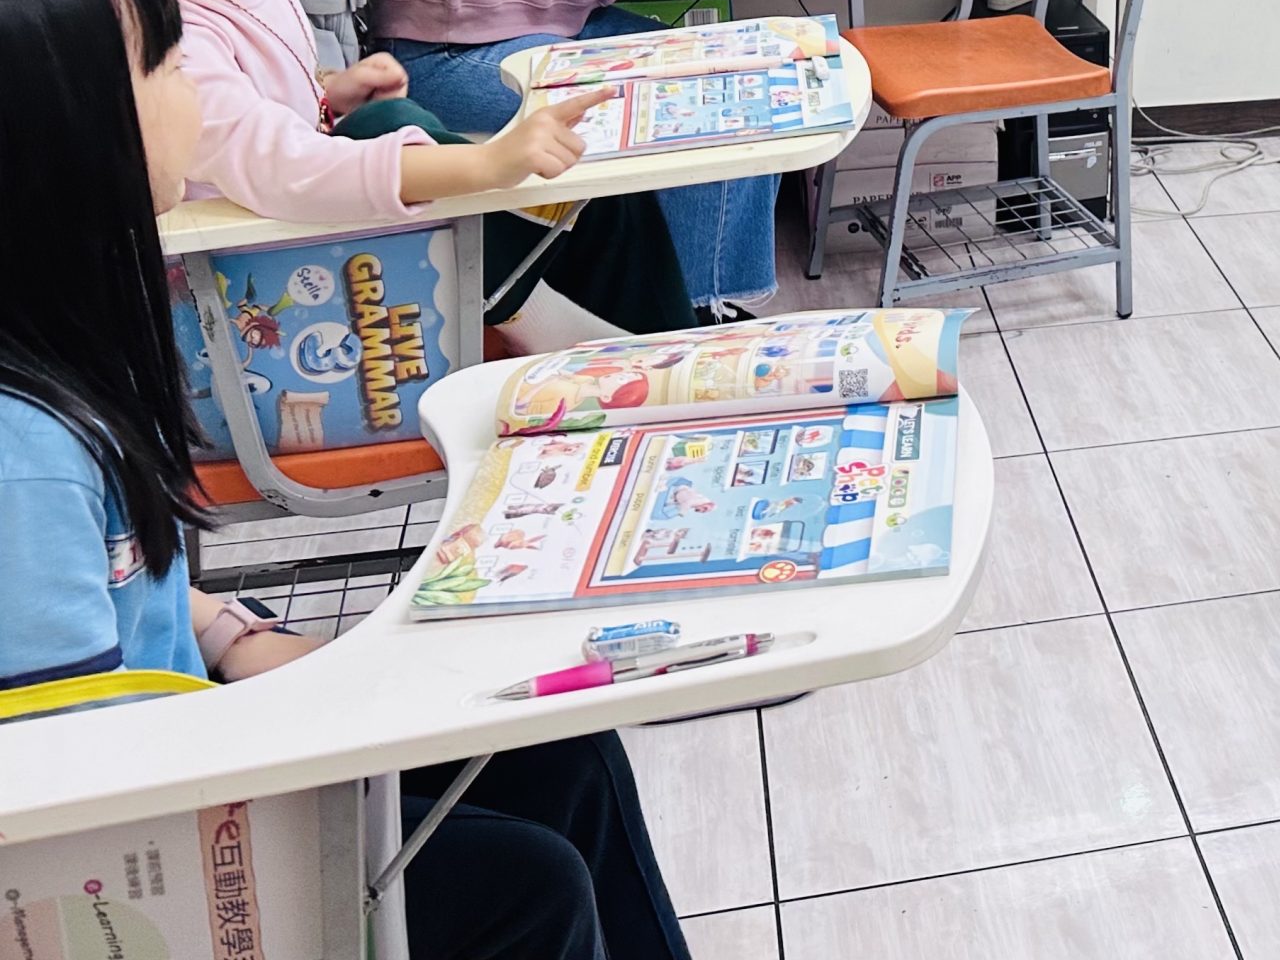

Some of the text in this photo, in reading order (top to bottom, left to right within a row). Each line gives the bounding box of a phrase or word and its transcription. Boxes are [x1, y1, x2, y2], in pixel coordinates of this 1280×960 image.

[299, 330, 362, 375] 3
[343, 253, 429, 429] LIVE GRAMMAR
[900, 419, 915, 458] LET'S LEARN
[858, 466, 885, 494] pet
[211, 801, 258, 960] e互動教學
